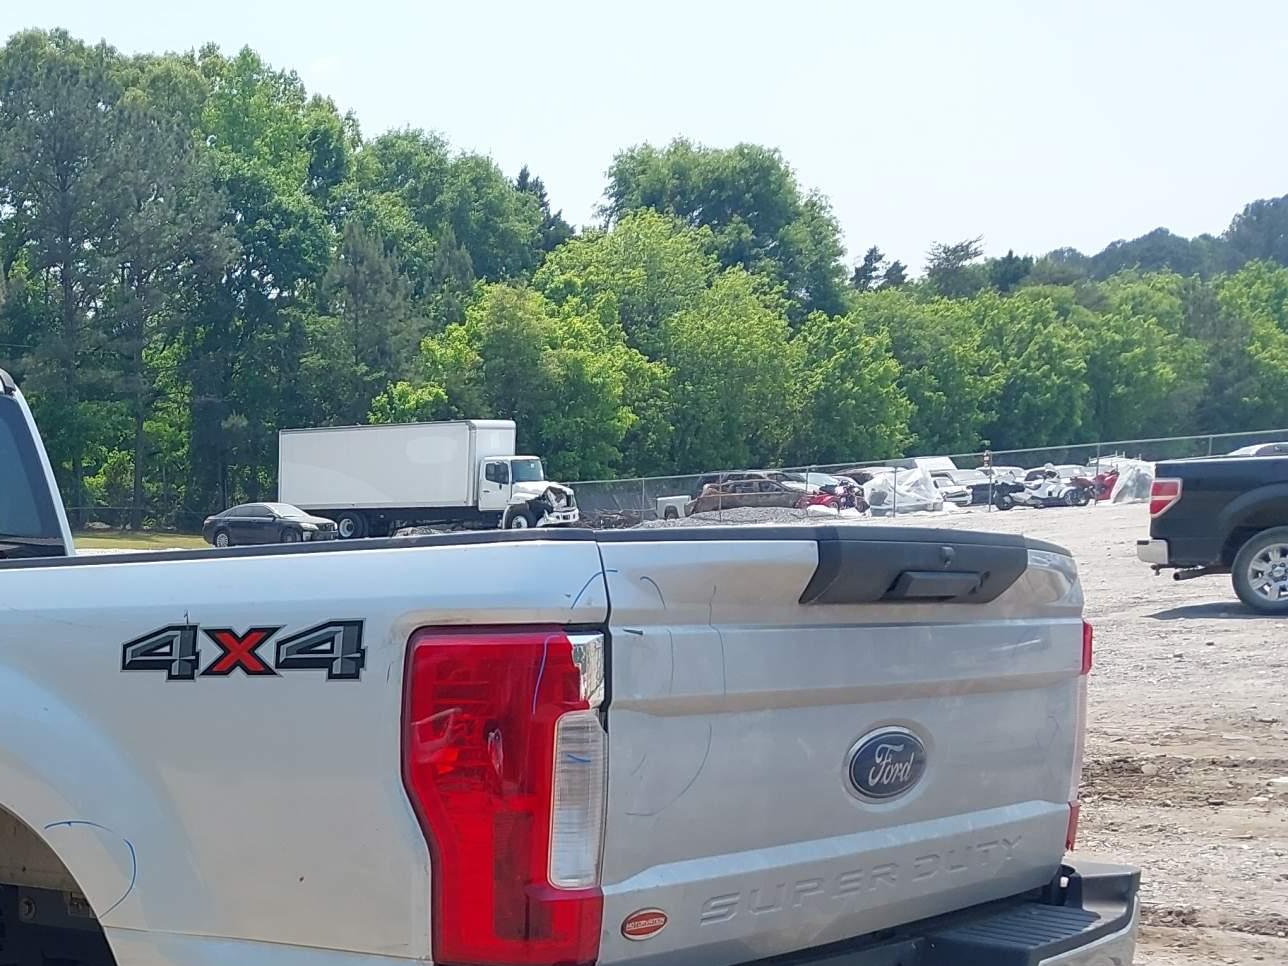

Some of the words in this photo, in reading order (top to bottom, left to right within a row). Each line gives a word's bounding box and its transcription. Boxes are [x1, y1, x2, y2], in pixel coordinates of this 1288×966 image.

[868, 743, 915, 786] Ford
[699, 862, 900, 927] SUPER
[911, 834, 1024, 882] DUTY
